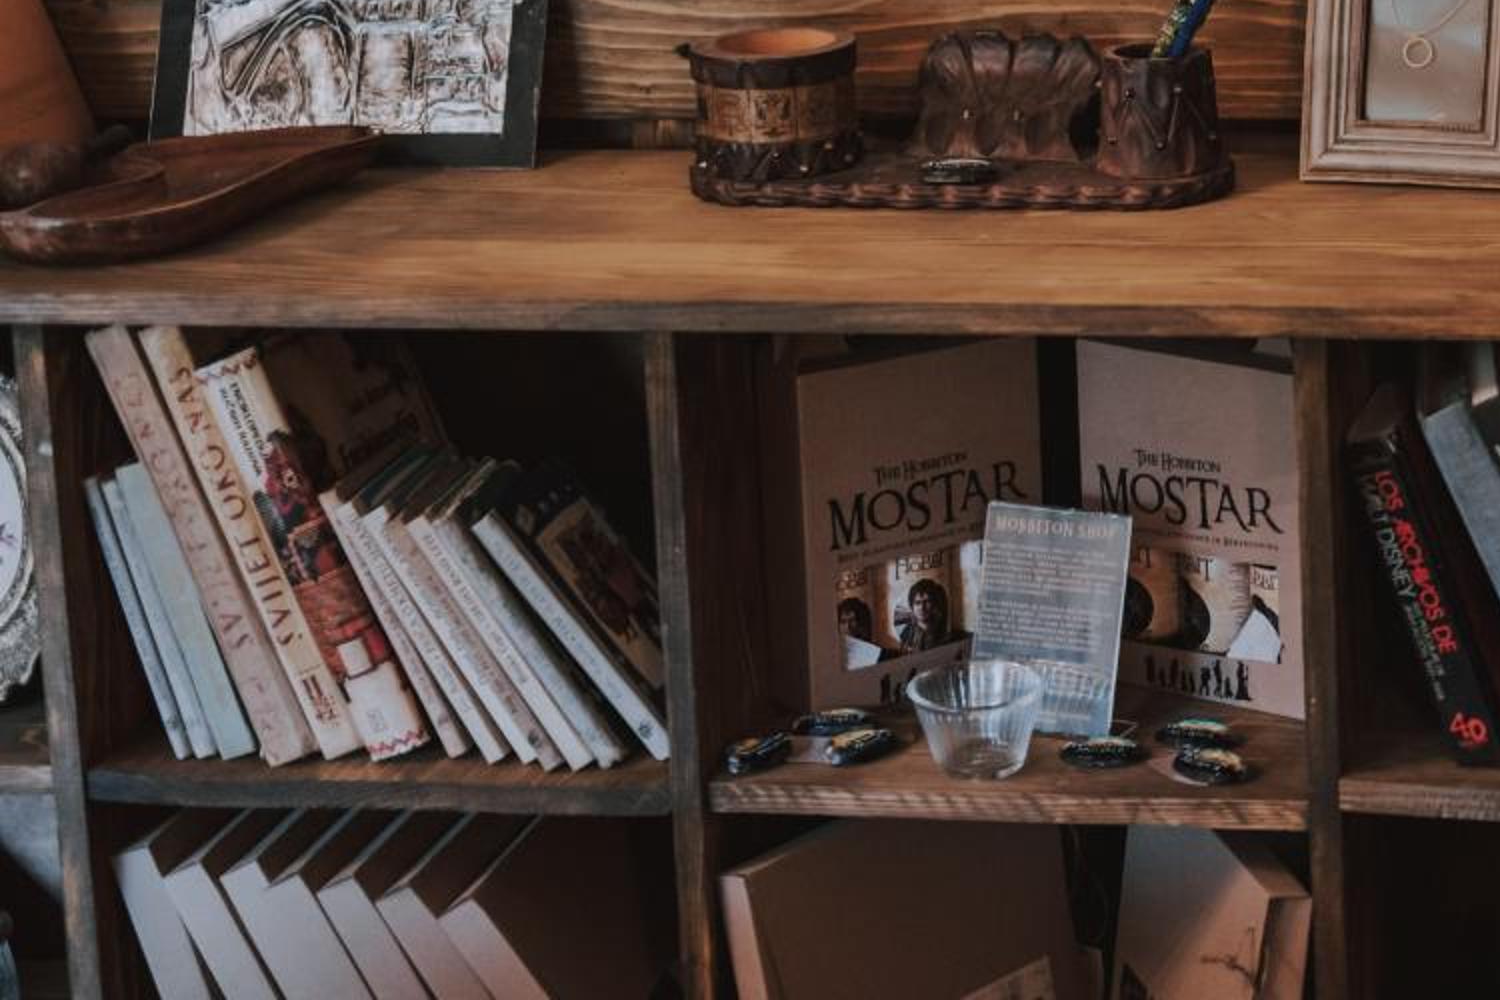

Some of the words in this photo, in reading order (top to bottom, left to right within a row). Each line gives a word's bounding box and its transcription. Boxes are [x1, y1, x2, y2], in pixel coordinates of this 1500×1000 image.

[201, 444, 247, 521] OKO
[827, 461, 1028, 551] MOSTAR
[1097, 464, 1285, 534] MOSTAR
[239, 534, 294, 647] SVIJET
[1375, 471, 1405, 511] LOS
[1395, 519, 1445, 621] ARCHIVOS
[1431, 623, 1457, 653] DE
[1378, 527, 1417, 598] DISNEY
